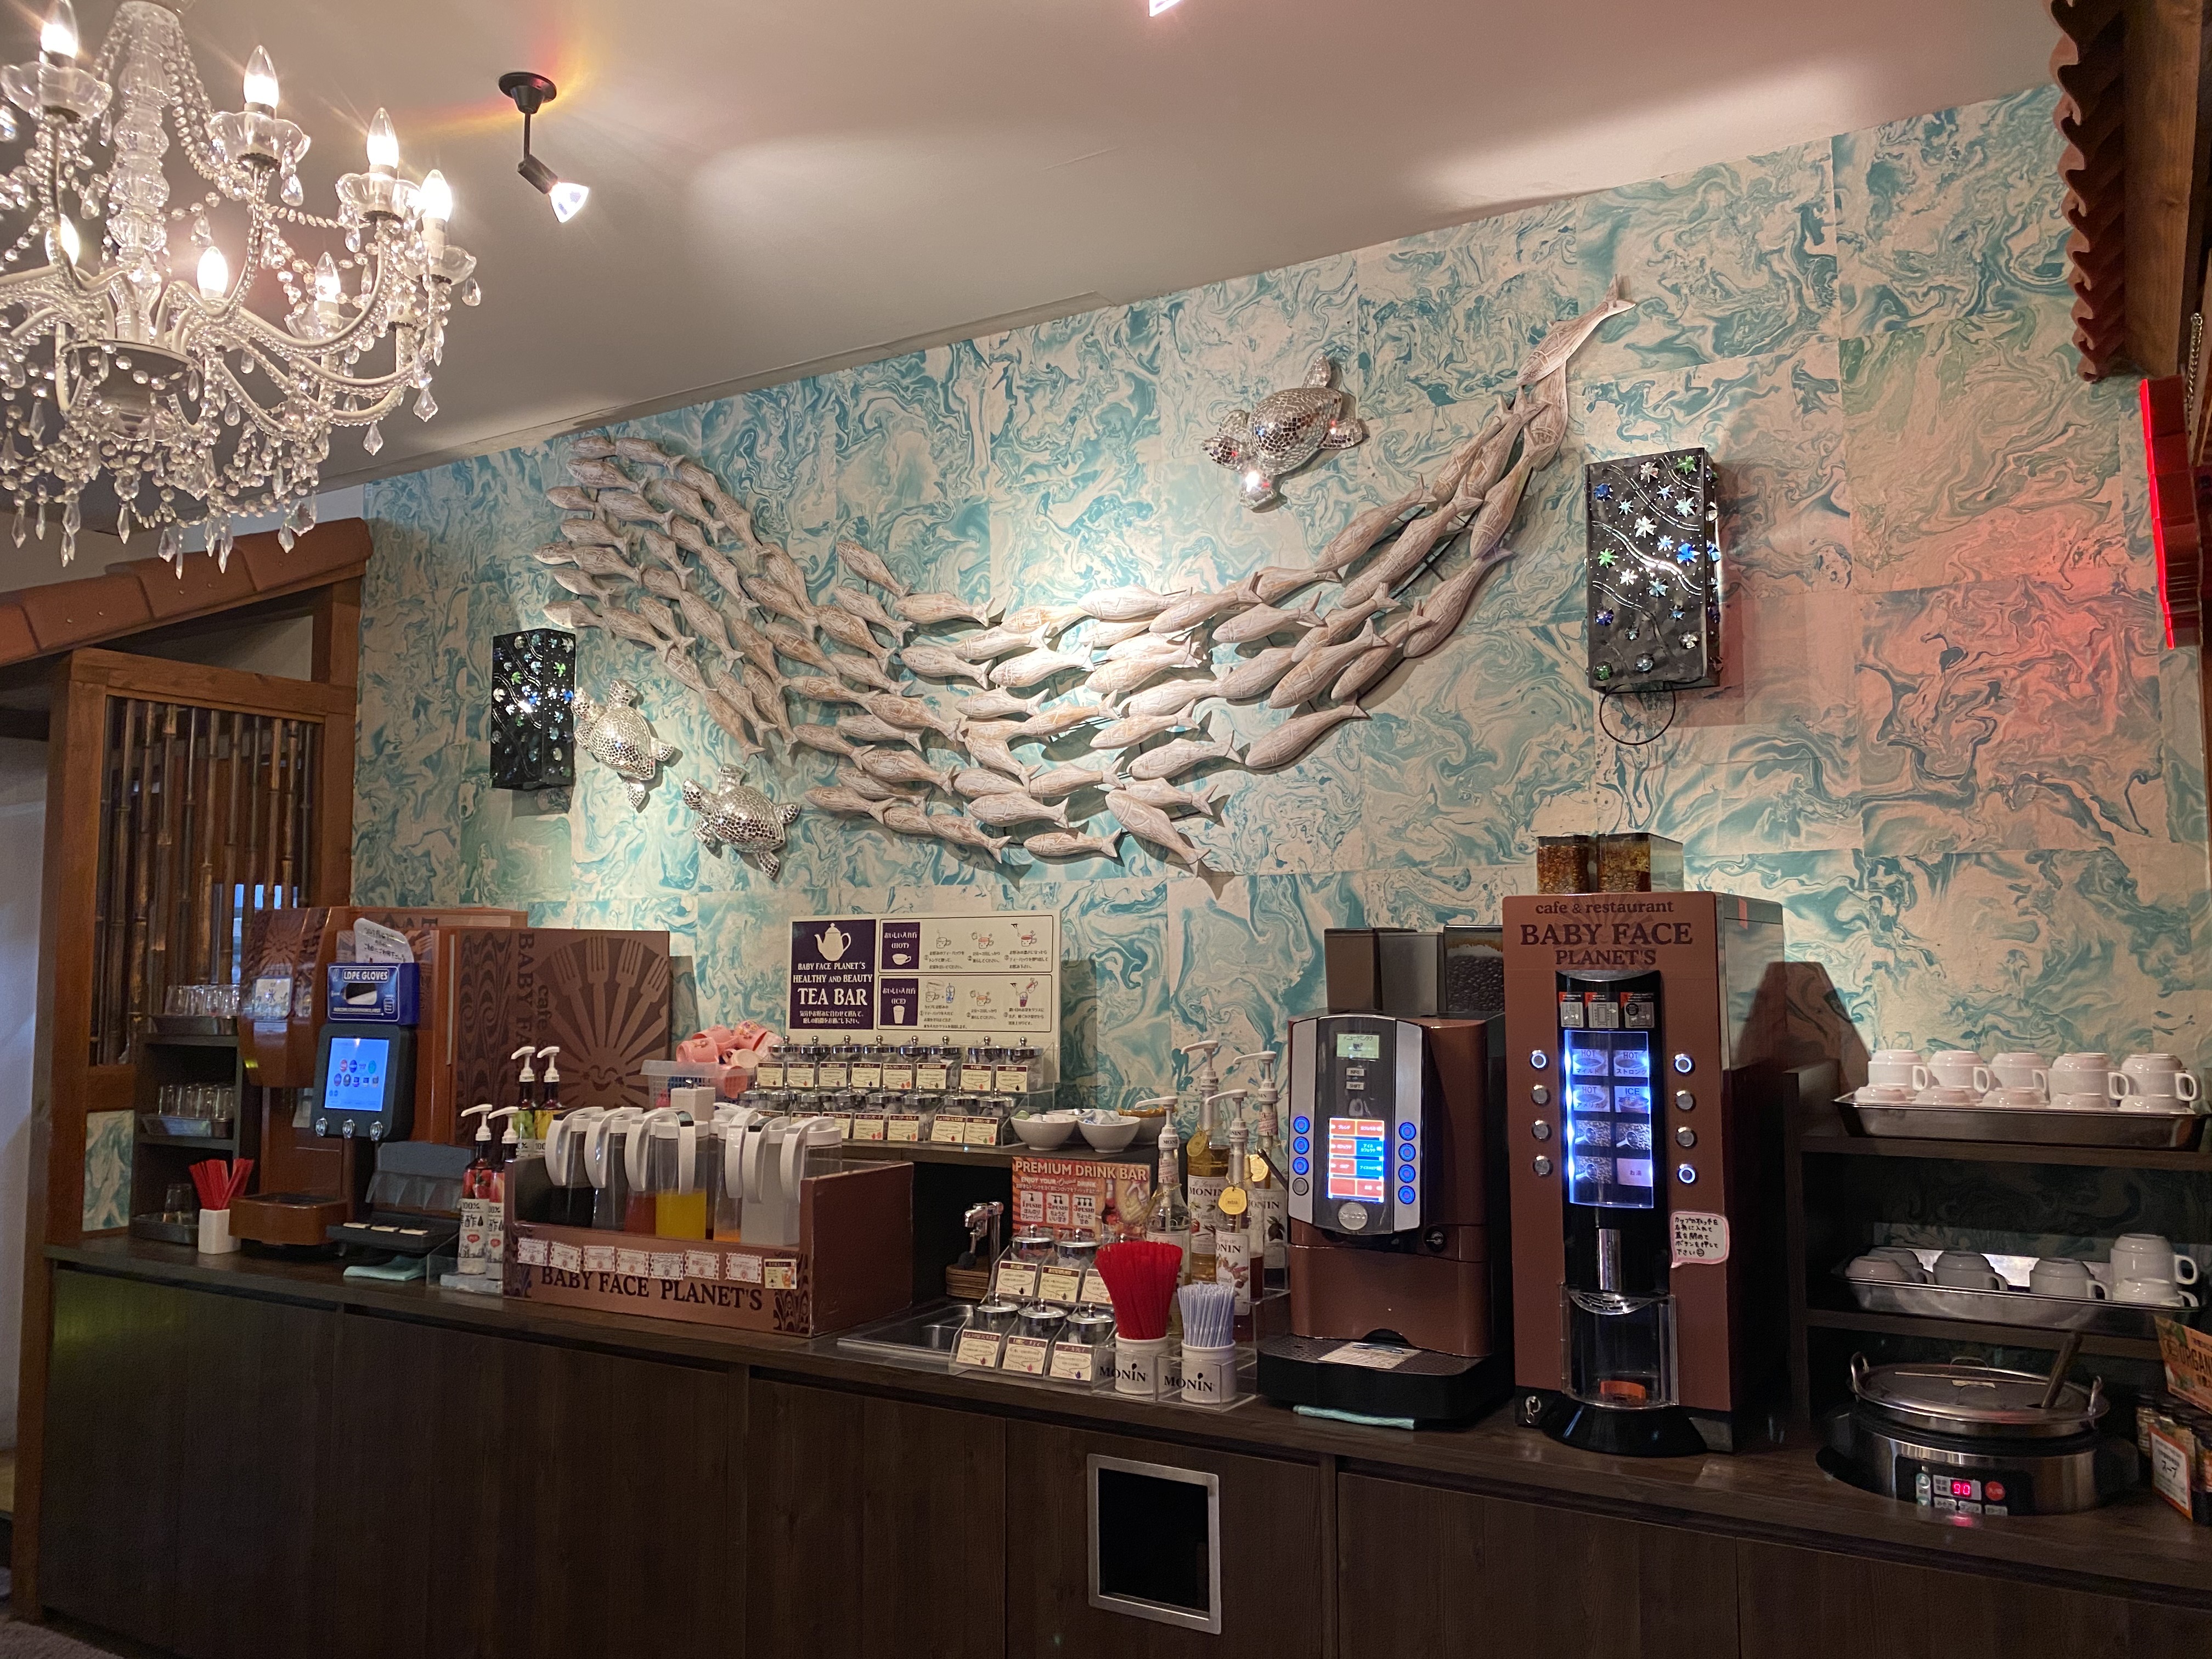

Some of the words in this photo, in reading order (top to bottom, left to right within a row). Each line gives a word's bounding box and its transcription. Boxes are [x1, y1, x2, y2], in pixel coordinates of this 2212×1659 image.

[1536, 901, 1567, 914] cafe
[1572, 904, 1582, 913] &
[1585, 901, 1673, 913] restaurant
[1520, 924, 1602, 945] BABY
[1611, 922, 1693, 945] FACE
[834, 962, 866, 970] PLANET'S
[1555, 950, 1657, 965] PLANET'S
[343, 972, 360, 980] LDPE
[362, 971, 388, 980] GLOVES
[517, 933, 534, 1008] BABY
[793, 974, 827, 983] HEALTHY
[843, 974, 873, 983] BEAUTY
[797, 988, 829, 1005] TEA
[833, 988, 868, 1006] BAR
[537, 984, 551, 1031] cafe
[1015, 1161, 1071, 1175] PREMIUM
[1075, 1165, 1116, 1179] DRINK
[1119, 1167, 1147, 1180] BAR
[1216, 1244, 1241, 1253] ONIN
[541, 1266, 595, 1290] BABY
[599, 1272, 650, 1297] FACE
[661, 1279, 763, 1311] PLANET'S
[1099, 1365, 1146, 1382] MONIN
[1164, 1375, 1212, 1392] MONIN
[1953, 1483, 1971, 1495] 90
